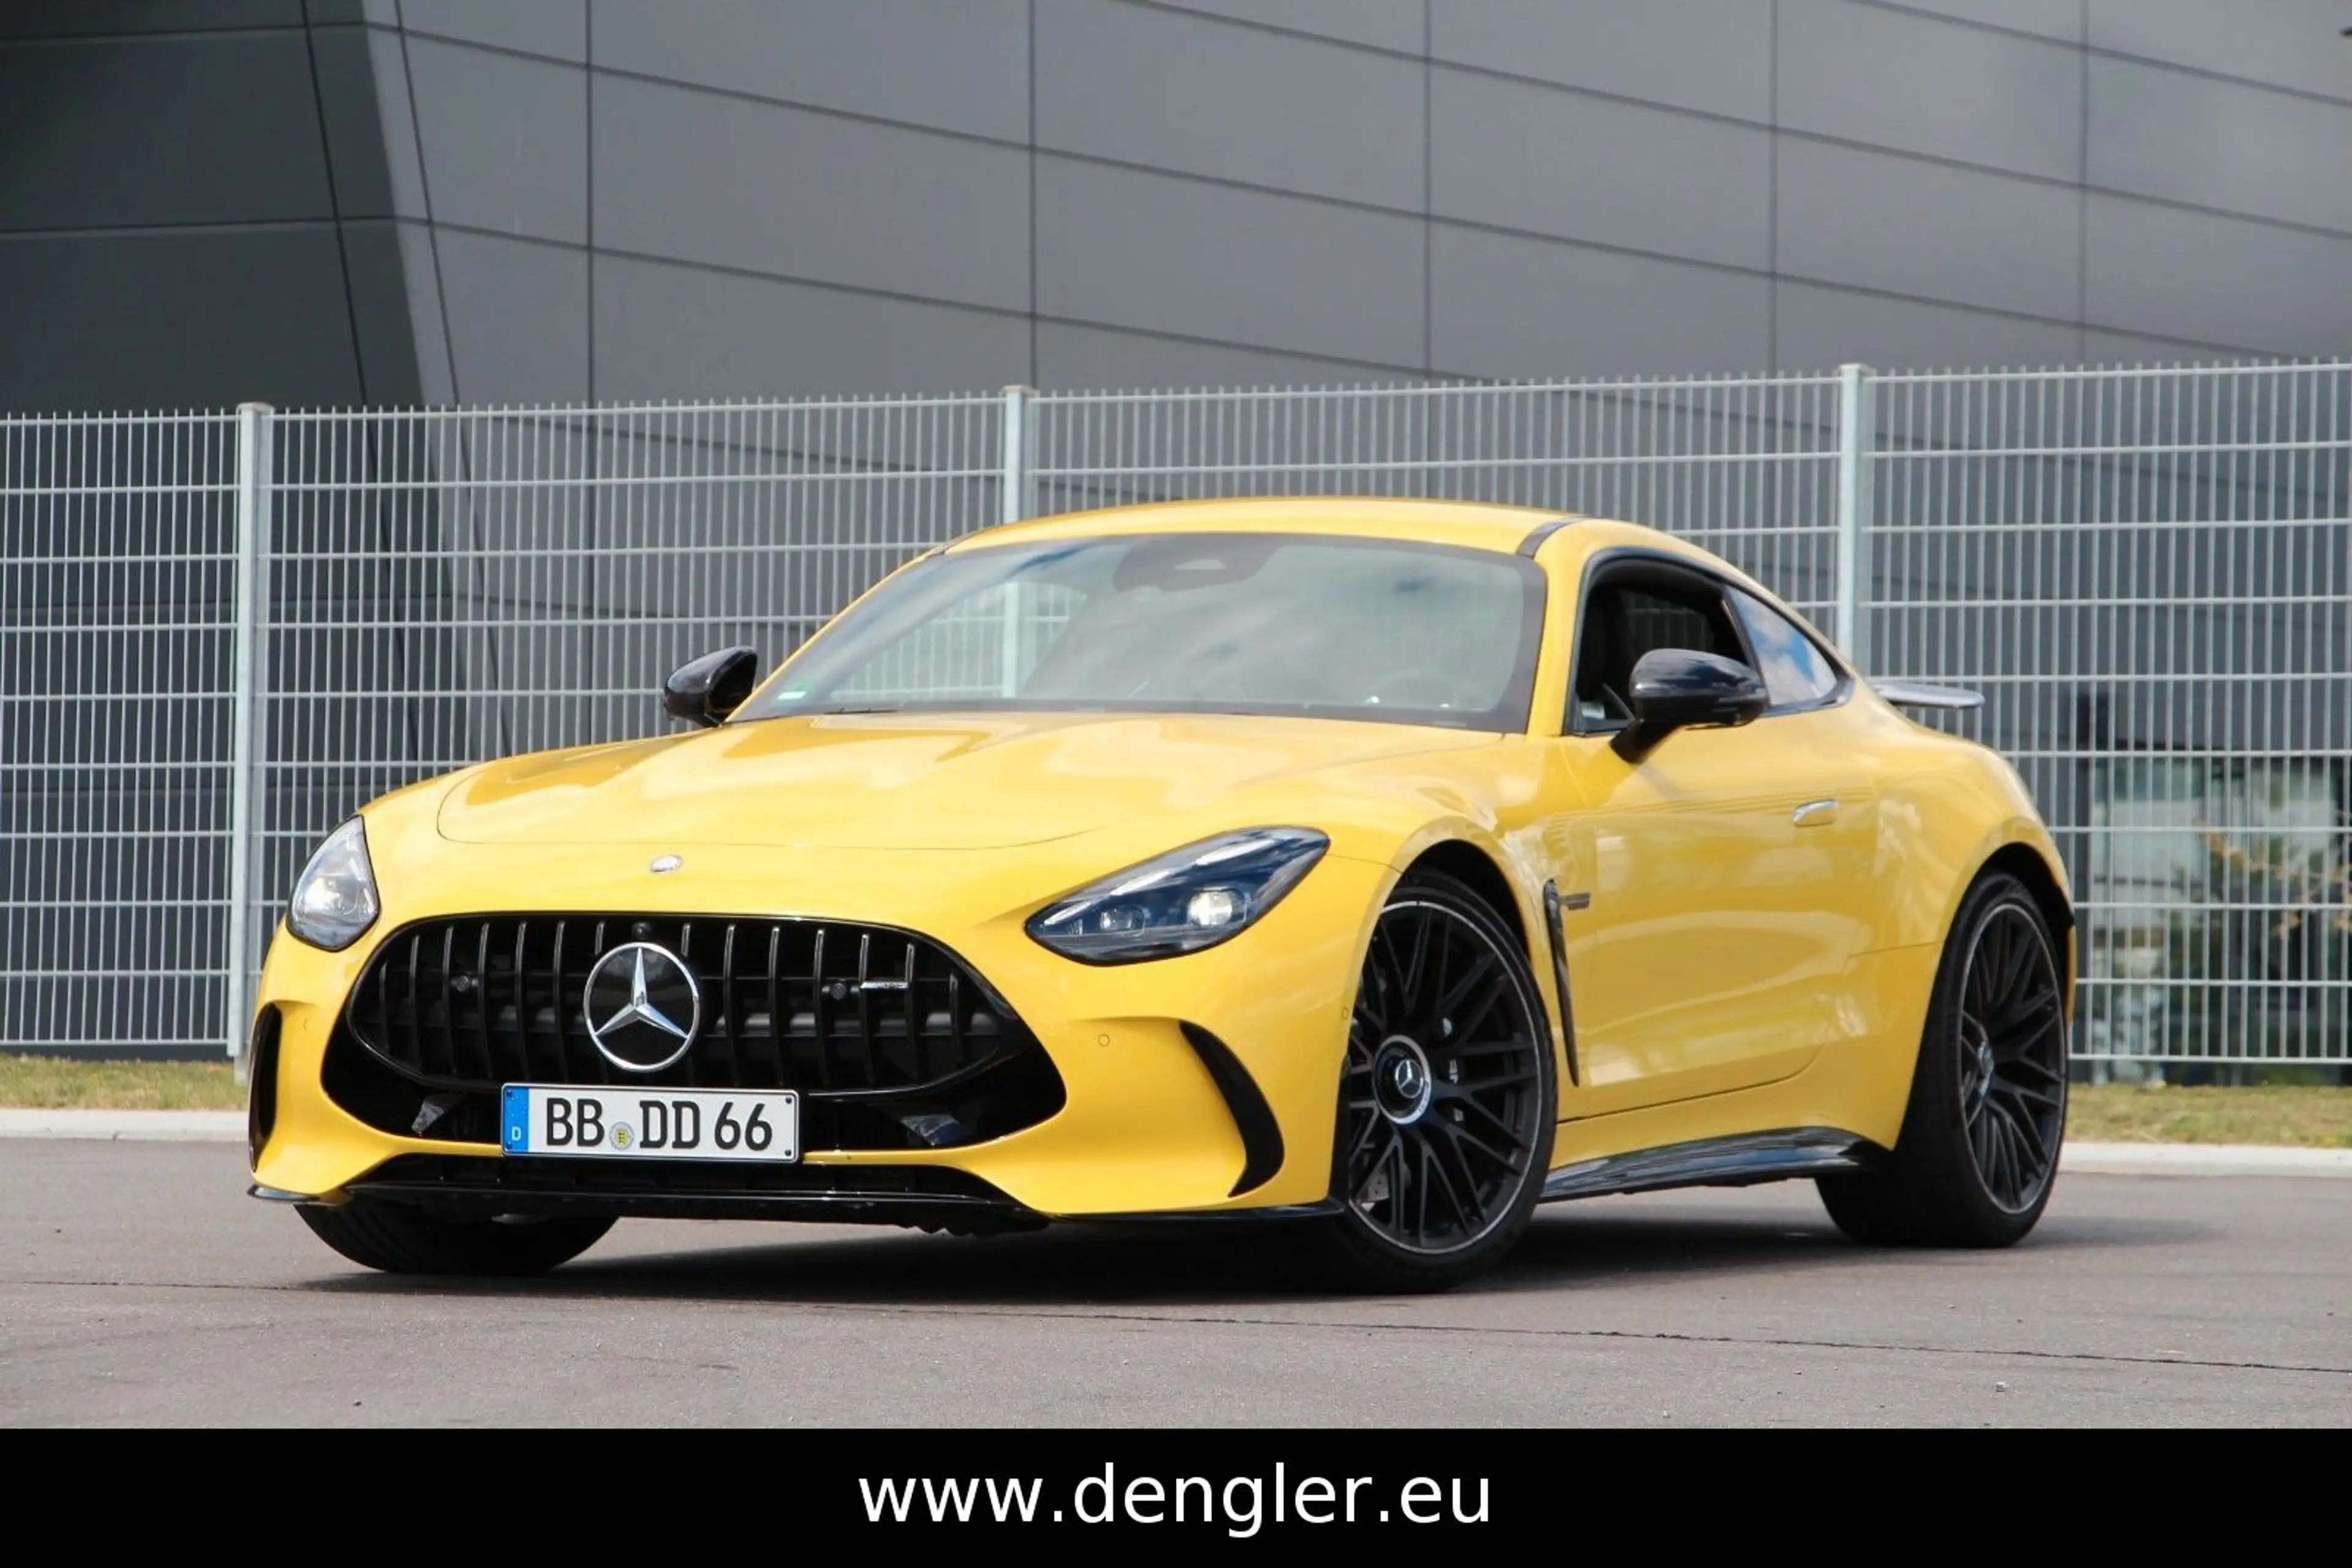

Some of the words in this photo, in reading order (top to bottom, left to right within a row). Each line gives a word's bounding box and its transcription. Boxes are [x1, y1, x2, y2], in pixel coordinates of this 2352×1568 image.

[511, 1126, 521, 1140] D
[546, 1098, 605, 1147] BB
[639, 1100, 701, 1149] DD
[714, 1102, 773, 1152] 66
